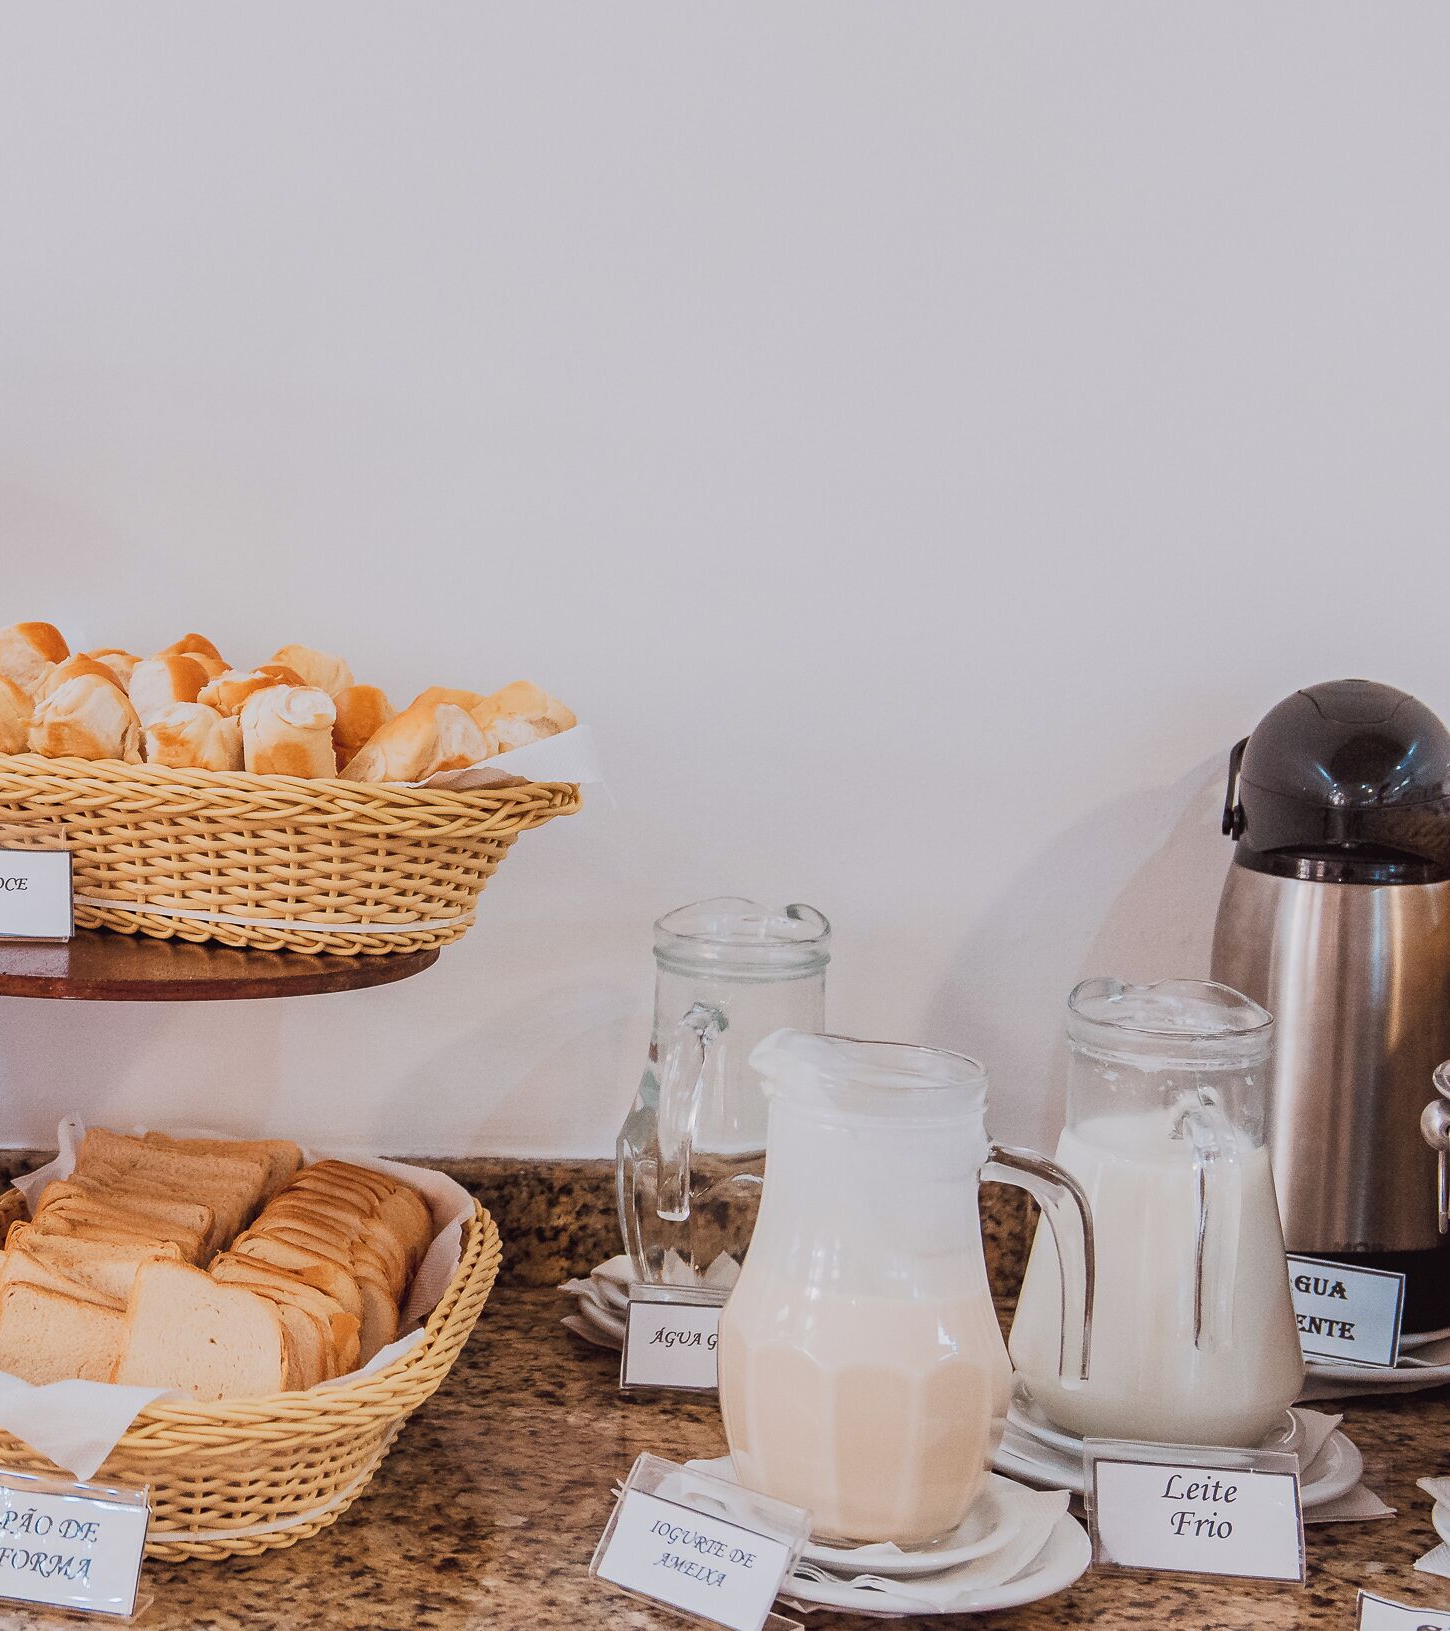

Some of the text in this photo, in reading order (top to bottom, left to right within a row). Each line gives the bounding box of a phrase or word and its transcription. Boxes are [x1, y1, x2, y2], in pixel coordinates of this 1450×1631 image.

[1290, 1275, 1348, 1300] GUA
[649, 1326, 702, 1348] ÁGUA
[1161, 1474, 1238, 1504] Leite
[58, 1518, 100, 1544] DE
[1170, 1511, 1233, 1539] Frio
[649, 1520, 758, 1569] IOGURTE DE
[653, 1551, 727, 1588] AMEIXA
